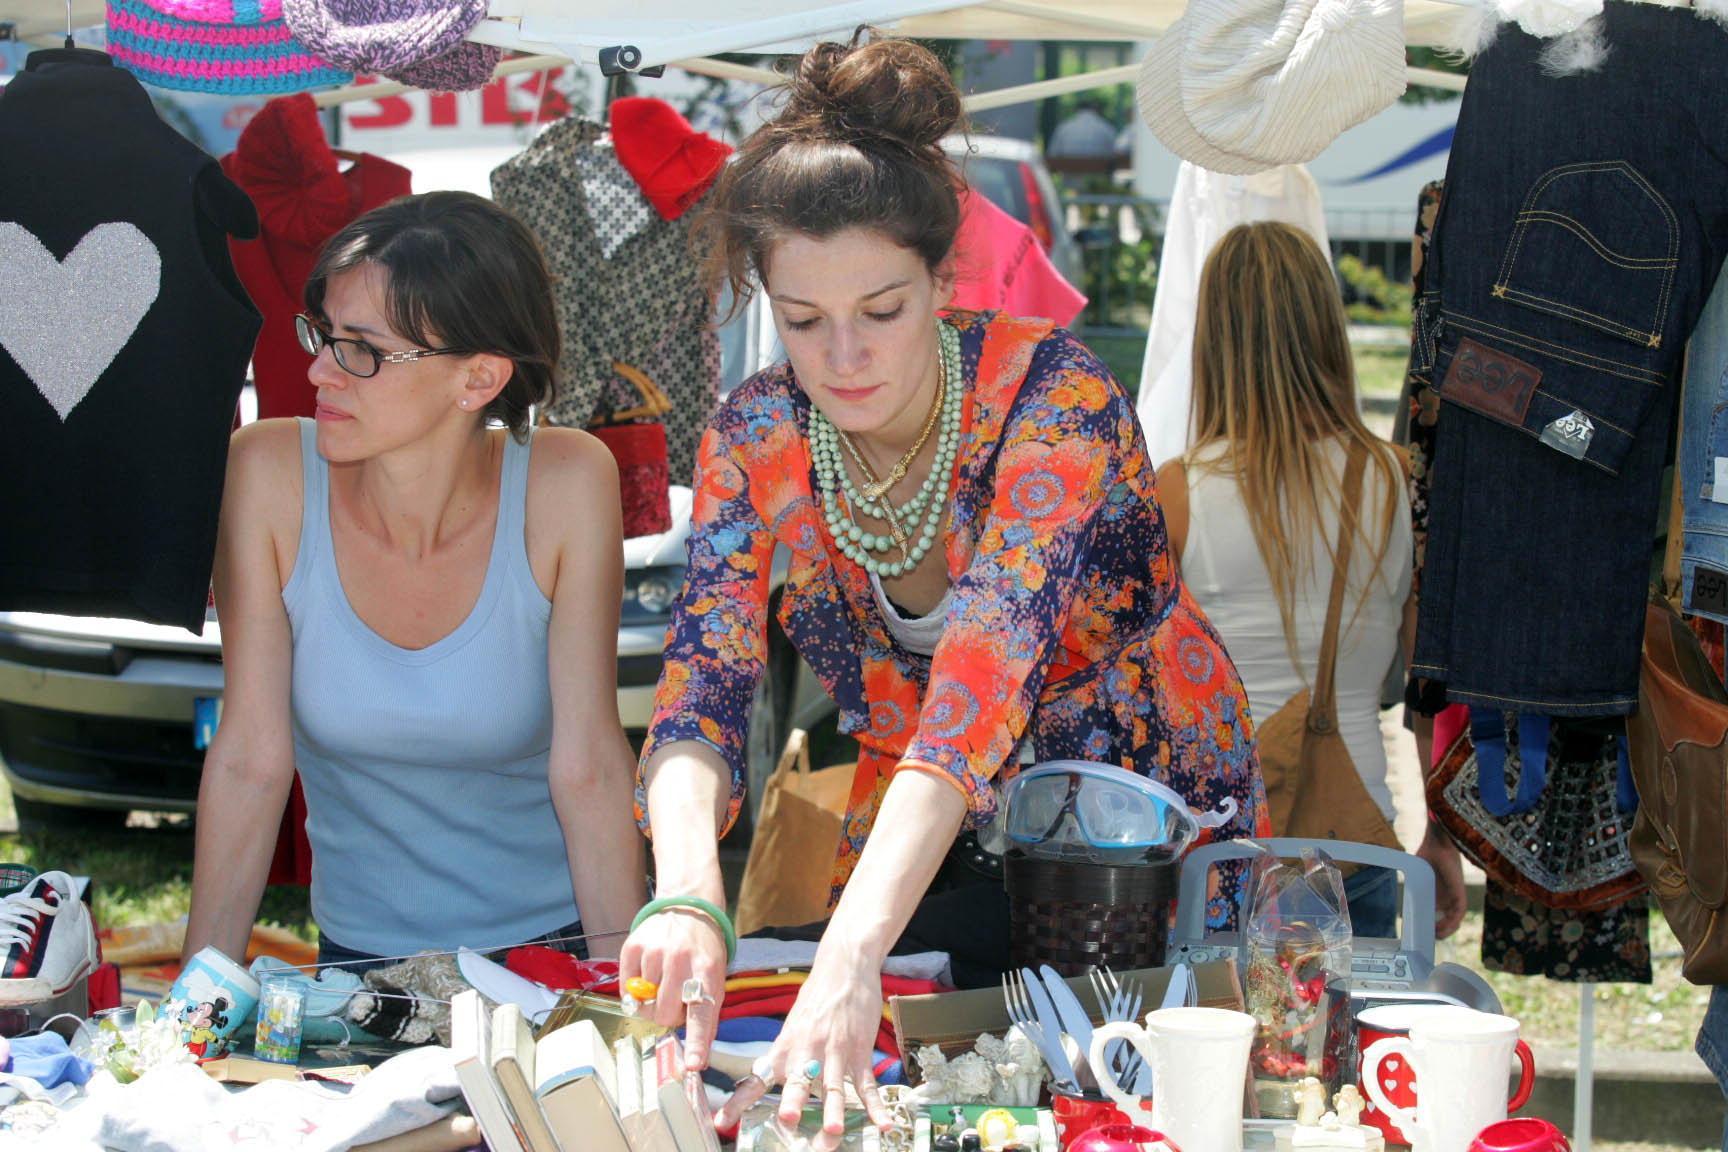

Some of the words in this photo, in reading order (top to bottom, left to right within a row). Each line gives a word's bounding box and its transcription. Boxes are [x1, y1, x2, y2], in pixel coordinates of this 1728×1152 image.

[1456, 349, 1534, 415] Lee
[1555, 419, 1590, 440] Lee
[1696, 574, 1727, 608] Lee
